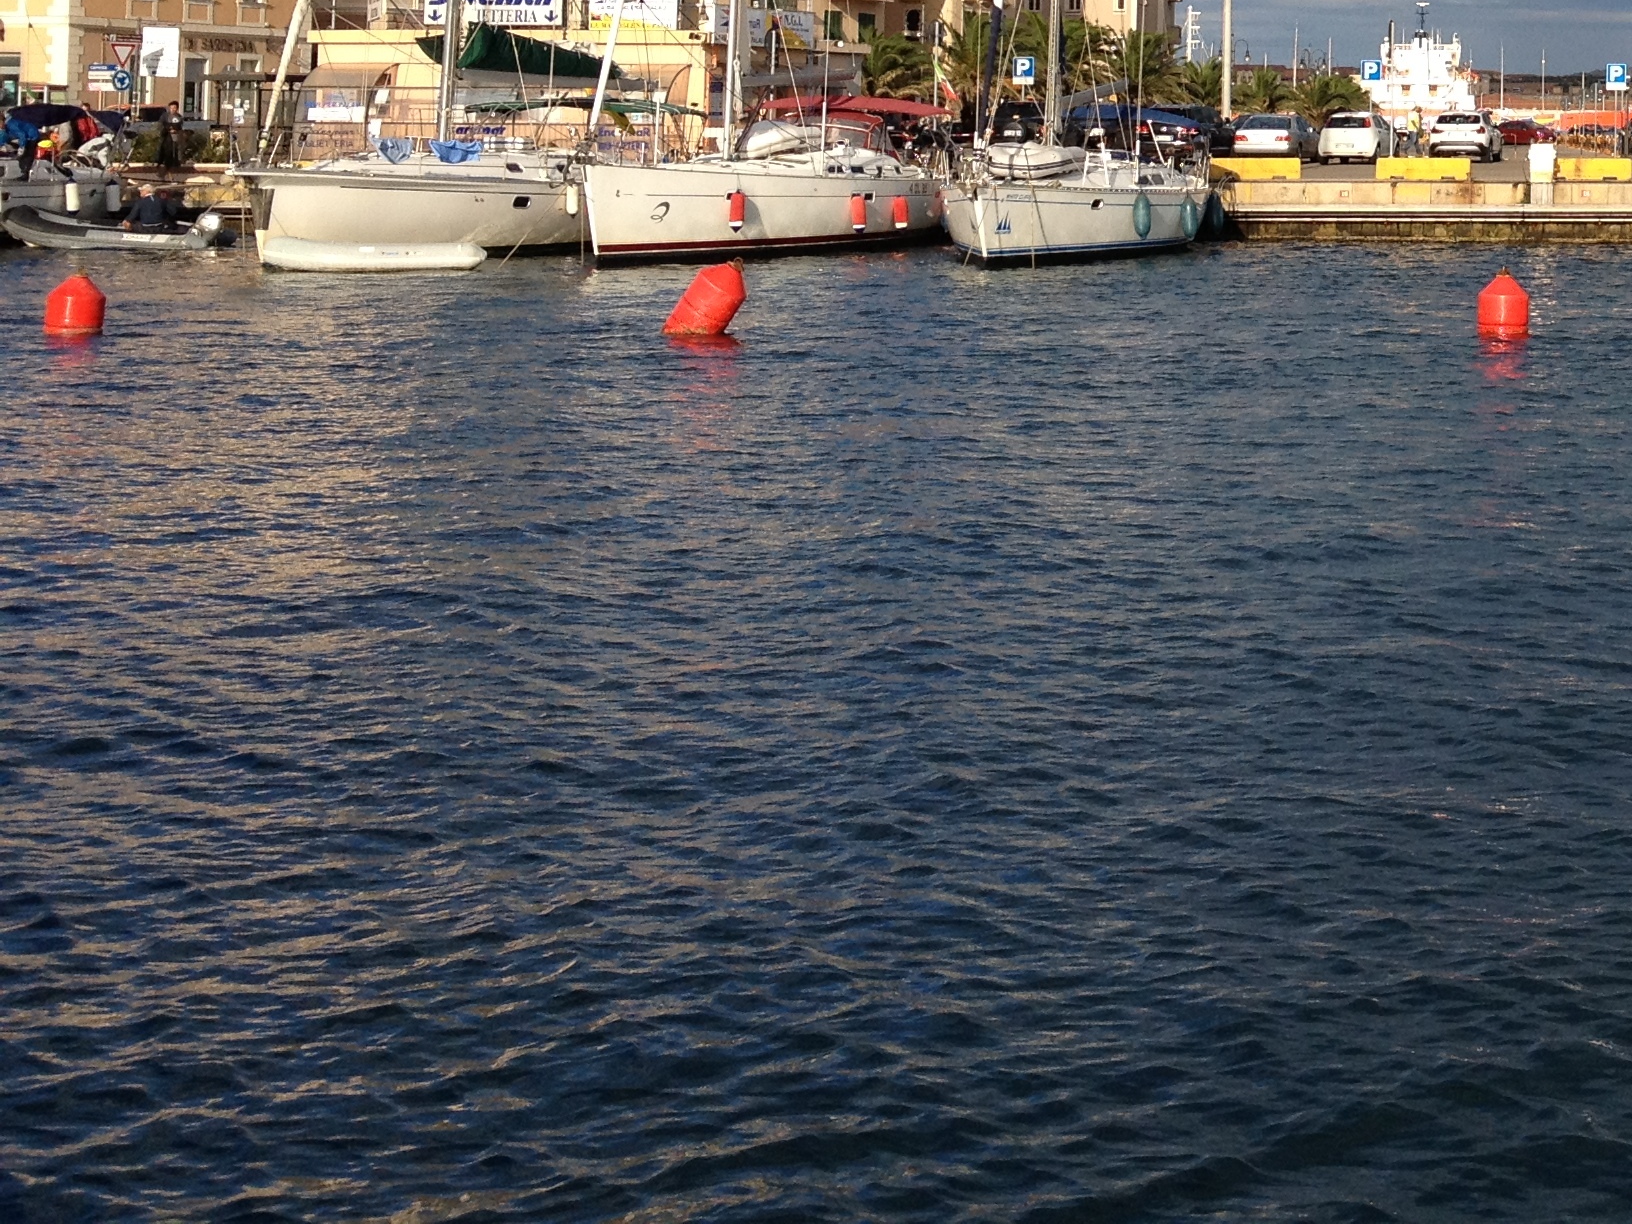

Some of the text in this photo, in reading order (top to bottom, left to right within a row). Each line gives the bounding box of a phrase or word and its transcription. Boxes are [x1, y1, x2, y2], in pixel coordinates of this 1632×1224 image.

[1016, 58, 1031, 76] P
[1364, 61, 1378, 79] P
[1610, 65, 1624, 83] P
